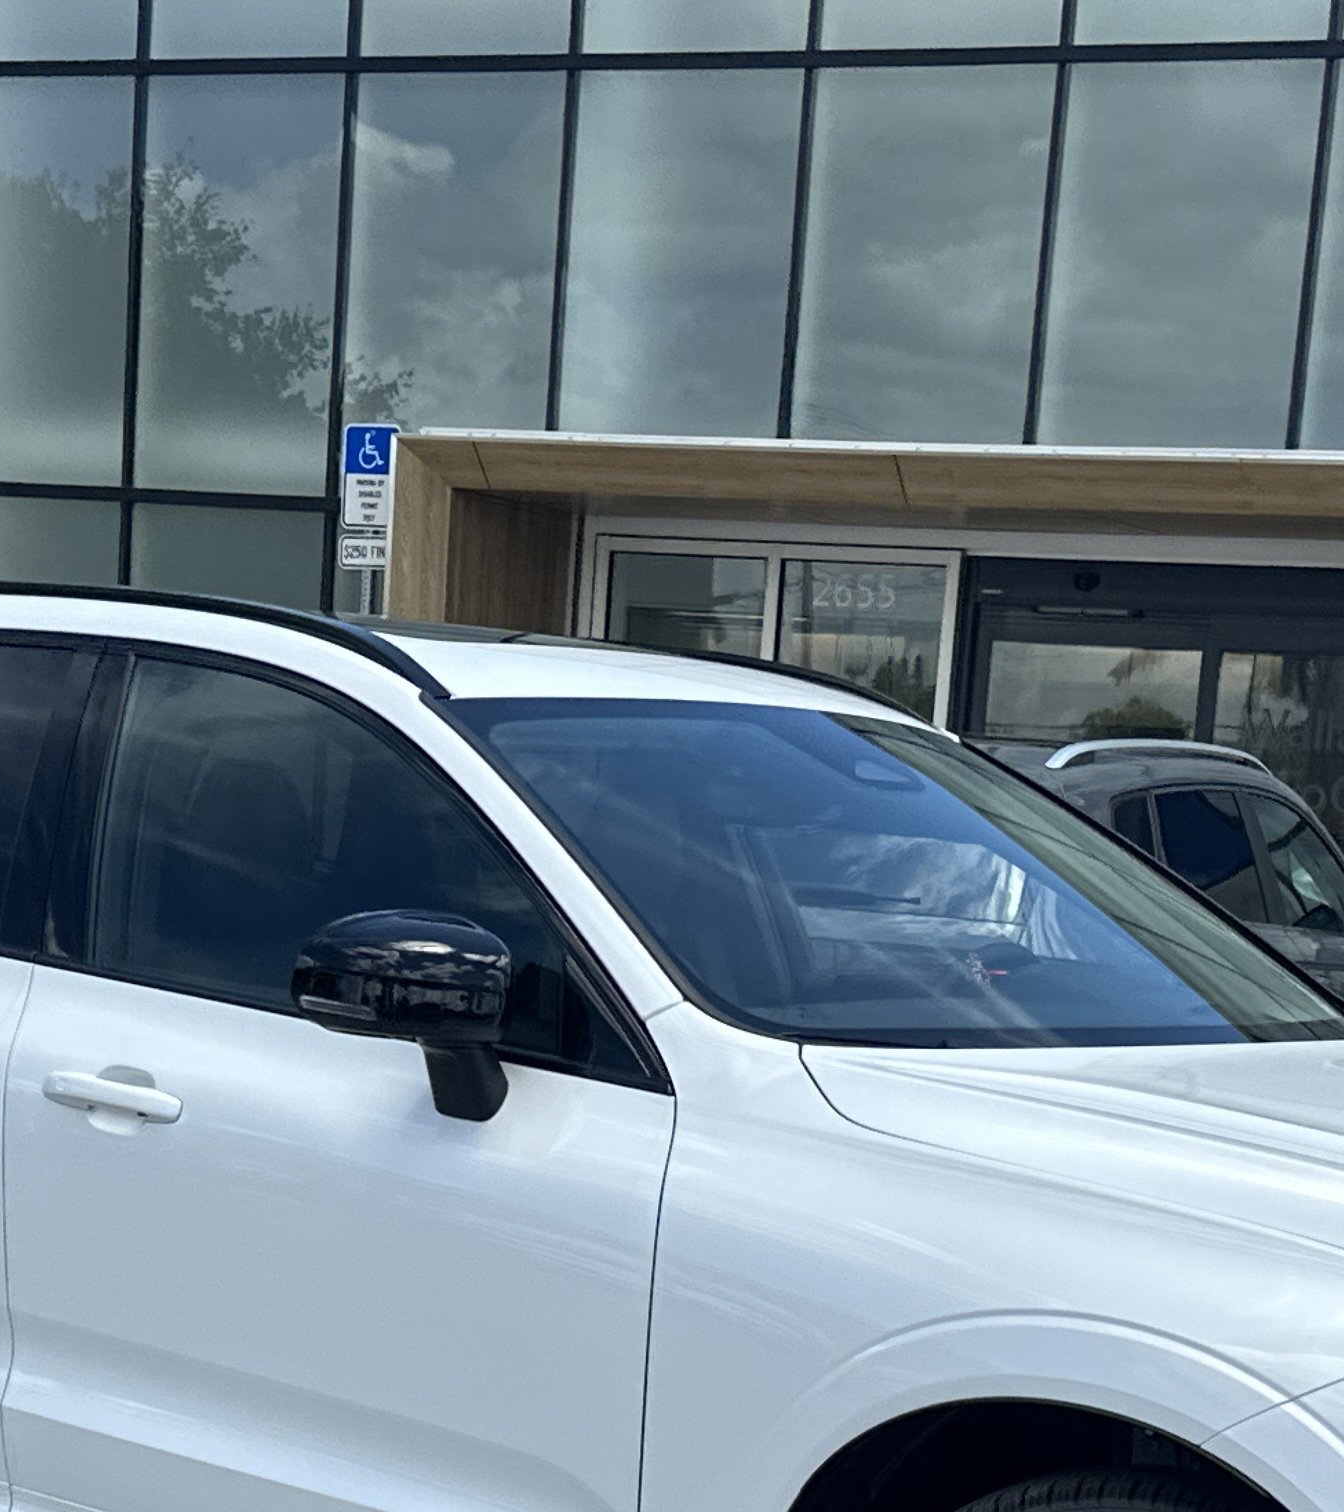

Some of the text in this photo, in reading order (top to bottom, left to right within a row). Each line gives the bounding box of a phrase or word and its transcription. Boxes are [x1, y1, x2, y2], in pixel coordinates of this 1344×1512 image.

[343, 543, 386, 560] $250 FIN
[812, 572, 897, 608] 2655
